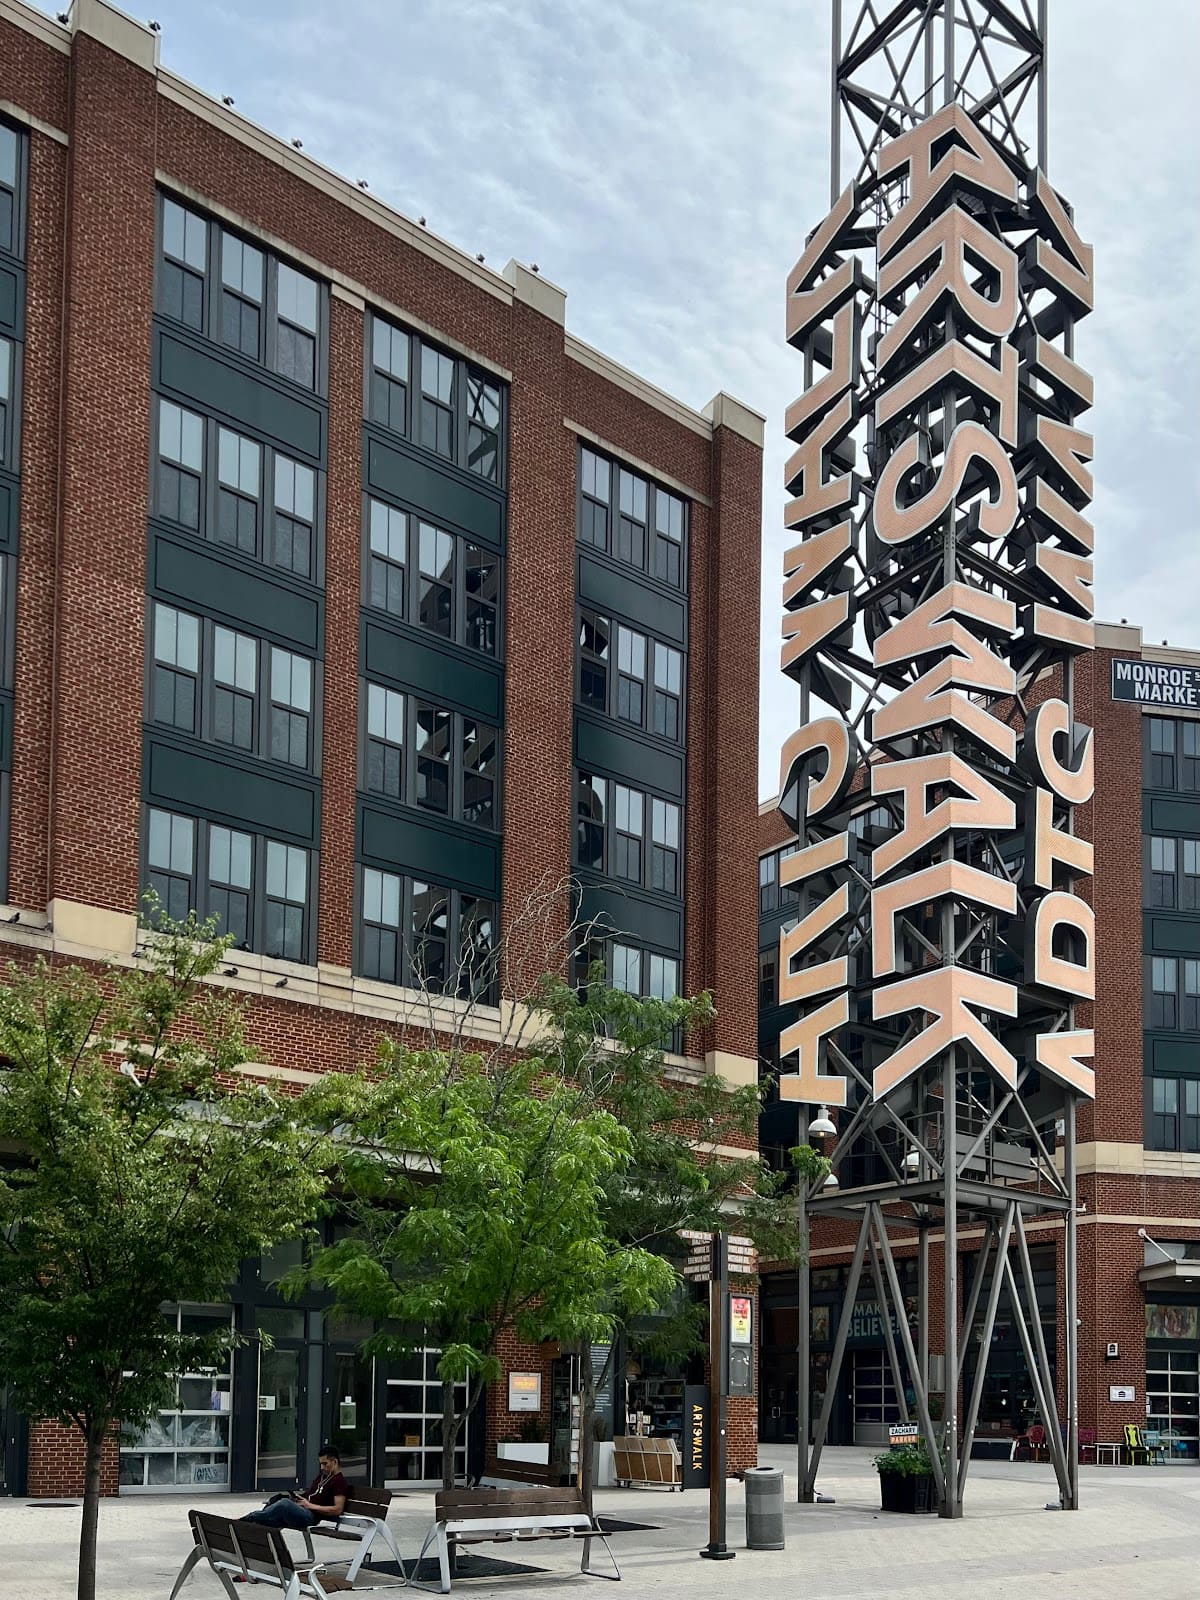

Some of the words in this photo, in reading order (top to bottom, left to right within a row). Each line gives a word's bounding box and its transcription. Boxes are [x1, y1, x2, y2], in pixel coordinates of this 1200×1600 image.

[872, 102, 1019, 545] ARTS
[1116, 662, 1193, 688] MONROE
[1134, 681, 1200, 705] MARKE
[870, 580, 1018, 1102] WALK
[853, 1303, 886, 1317] MAK
